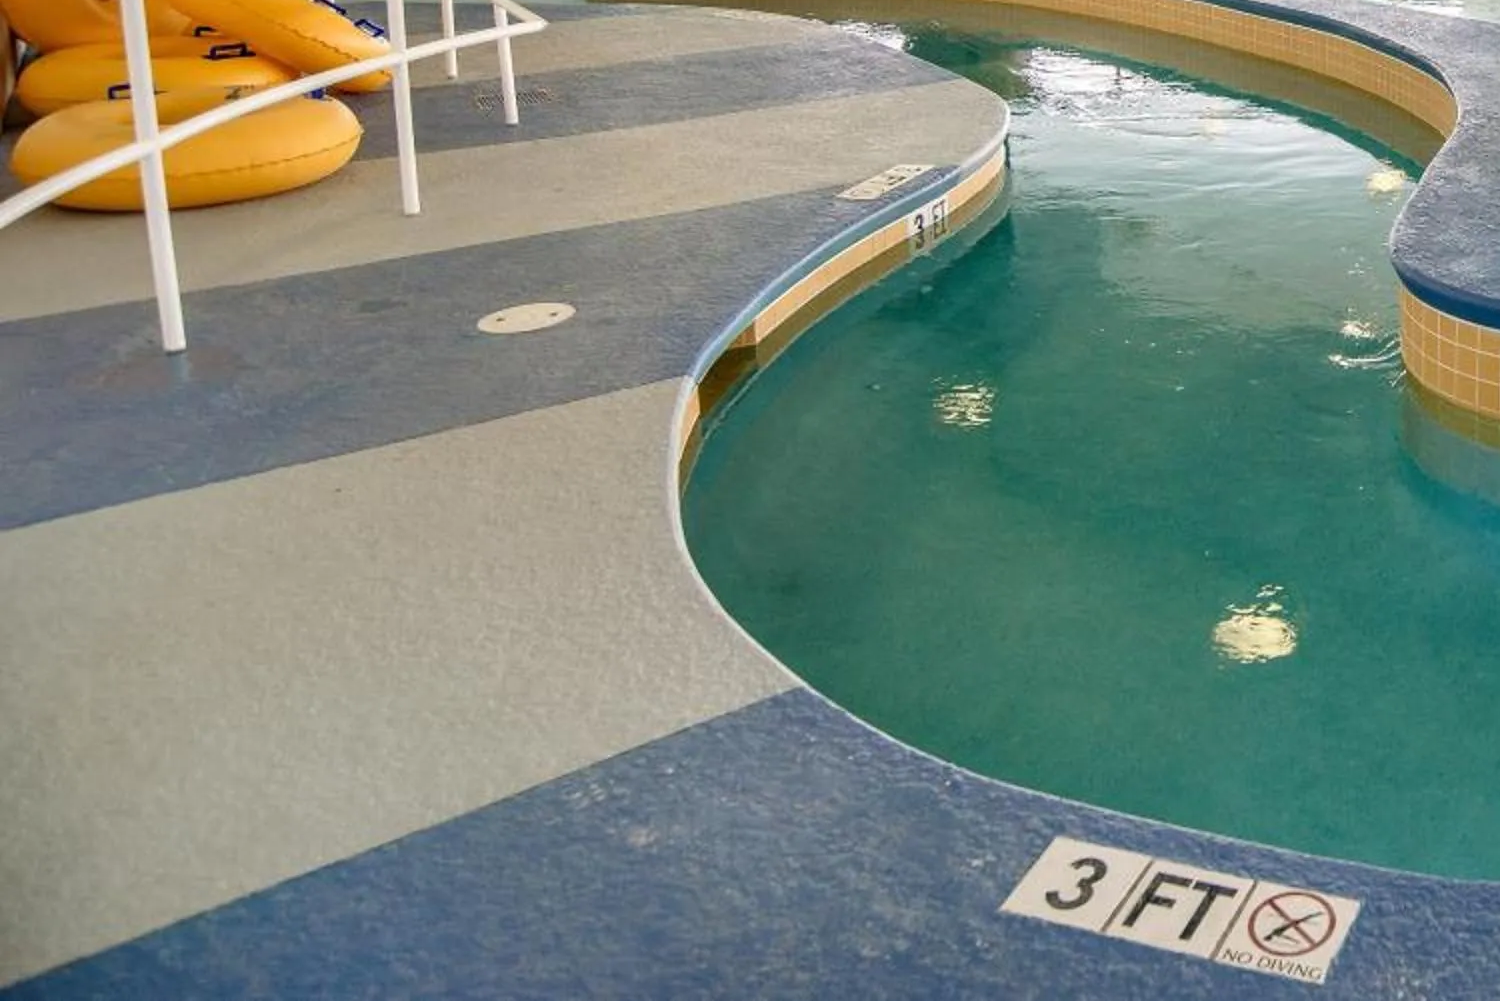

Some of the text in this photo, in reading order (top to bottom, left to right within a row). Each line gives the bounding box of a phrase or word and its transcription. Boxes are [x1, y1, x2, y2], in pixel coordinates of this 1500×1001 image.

[1044, 857, 1239, 941] 3 FT
[1221, 948, 1323, 981] NO DIVING
